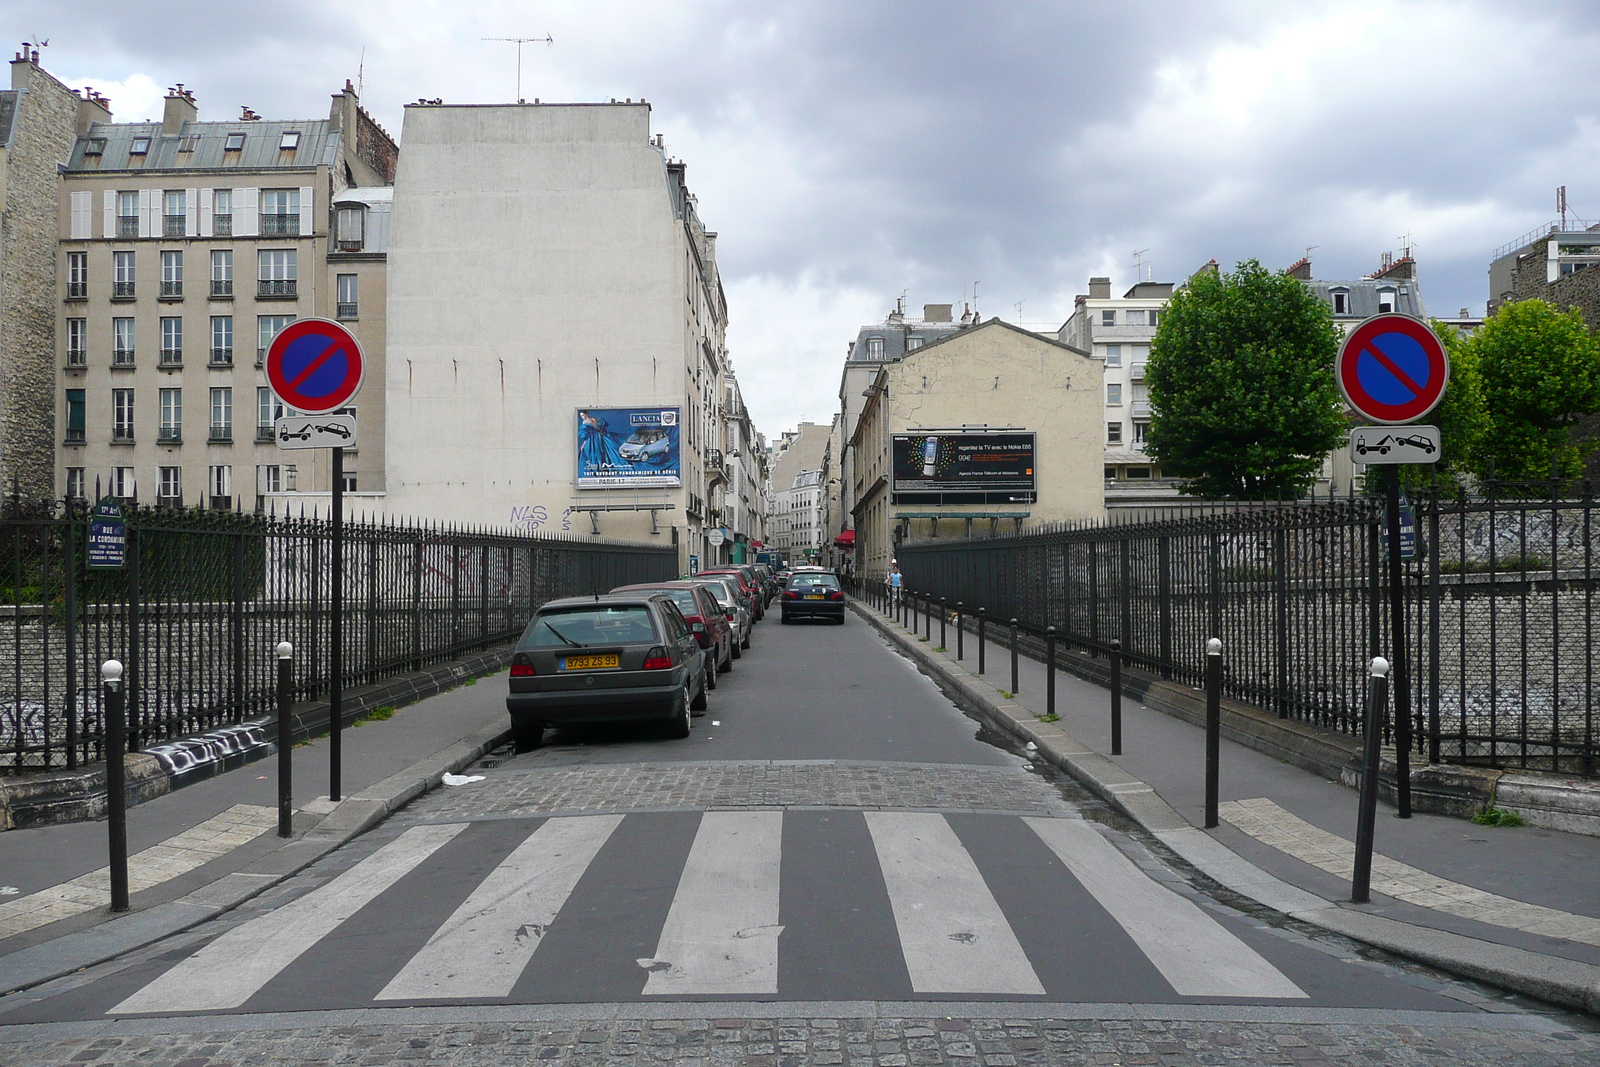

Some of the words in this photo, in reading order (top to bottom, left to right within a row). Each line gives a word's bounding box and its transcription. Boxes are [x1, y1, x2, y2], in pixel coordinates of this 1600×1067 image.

[632, 415, 661, 423] LANCIA
[103, 526, 113, 534] RUE
[1383, 528, 1389, 536] LA
[89, 535, 96, 543] LA
[97, 536, 125, 544] CONDAMINE
[567, 657, 590, 668] 9793
[591, 656, 603, 666] ZS
[604, 655, 617, 666] 93
